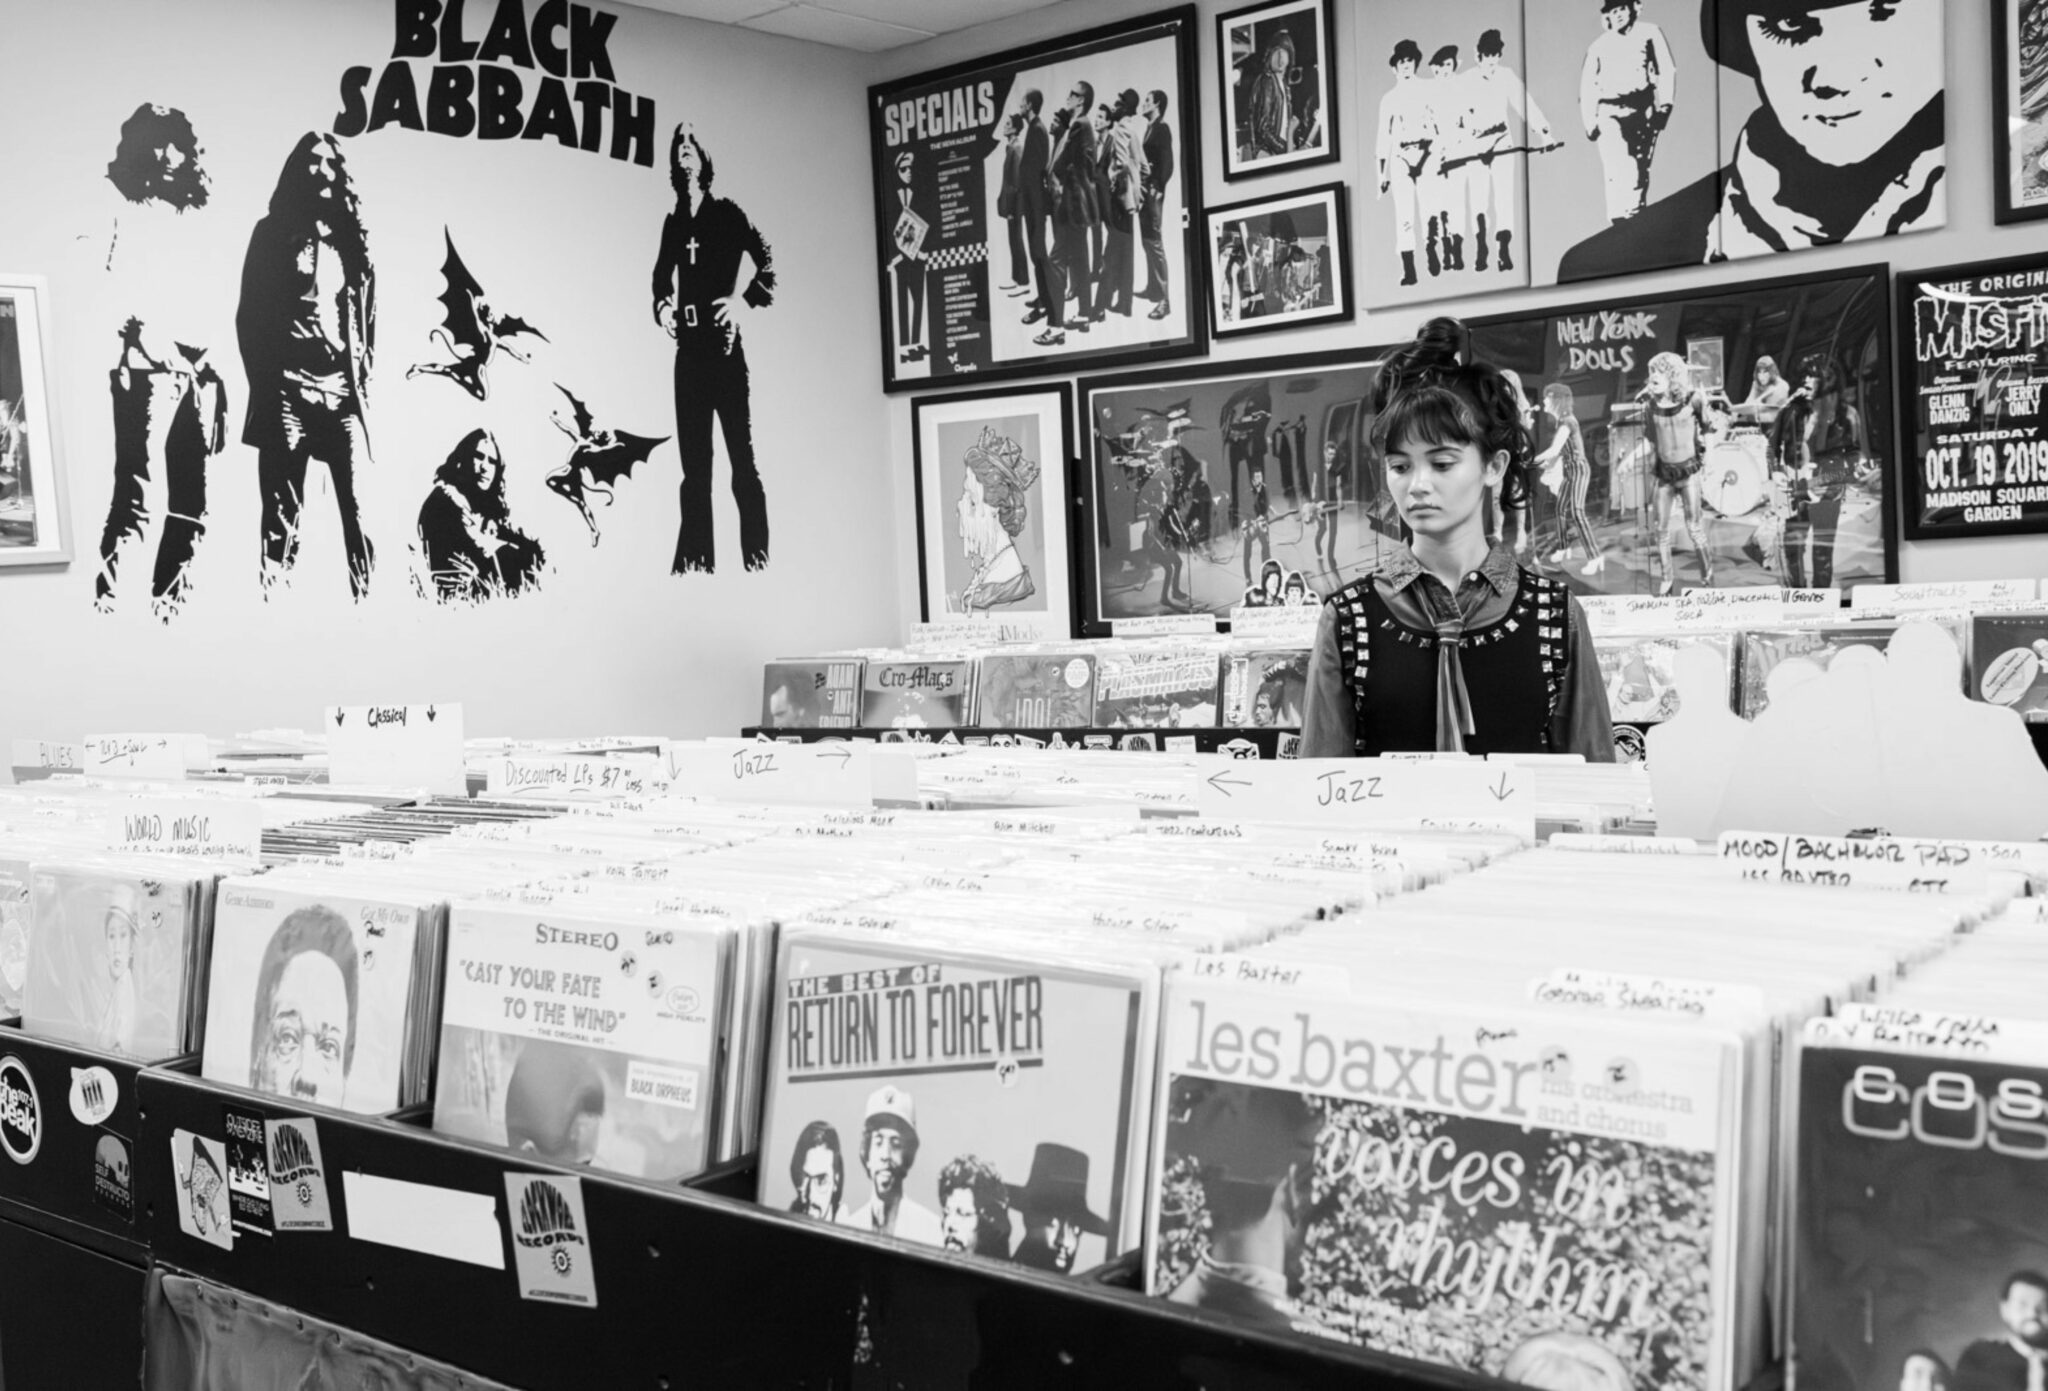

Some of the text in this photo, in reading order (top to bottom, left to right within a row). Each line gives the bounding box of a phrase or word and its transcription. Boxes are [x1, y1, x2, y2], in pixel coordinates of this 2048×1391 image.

[391, 0, 618, 84] BLACK
[333, 60, 655, 168] SABBATH
[885, 81, 994, 146] SPECIALS
[1980, 270, 2048, 292] ORIGIN
[1557, 311, 1657, 346] NEW YORK
[1569, 345, 1634, 373] DOLLS
[1944, 354, 2038, 370] FEATURING
[1928, 393, 1966, 409] GLENN
[2005, 384, 2042, 402] JERRY
[1930, 406, 1970, 425] DANZIG
[2009, 400, 2041, 417] ONLY
[1936, 427, 2038, 444] SATURDAY
[1925, 440, 2048, 490] OCT. 19 2019
[1925, 486, 2048, 508] MADISON SQUAR
[1963, 504, 2023, 523] GARDEN
[879, 666, 953, 691] Cro-Mags
[506, 761, 567, 788] Discounted
[733, 748, 779, 780] Jazz
[1317, 770, 1385, 806] Jazz
[125, 814, 211, 843] WORLD MUSIC
[535, 922, 620, 952] STEREO
[508, 965, 557, 993] YOUR
[562, 971, 603, 999] FATE
[788, 963, 941, 998] THE BEST OF
[1194, 957, 1303, 984] Les Baxter
[503, 996, 528, 1020] TO
[534, 1001, 567, 1027] THE
[787, 975, 1043, 1069] RETURN TO FOREVER
[1185, 1000, 1539, 1118] les baxter
[1537, 1102, 1667, 1139] and chorus
[1317, 1125, 1632, 1229] voices in
[1379, 1196, 1662, 1330] rhythm
